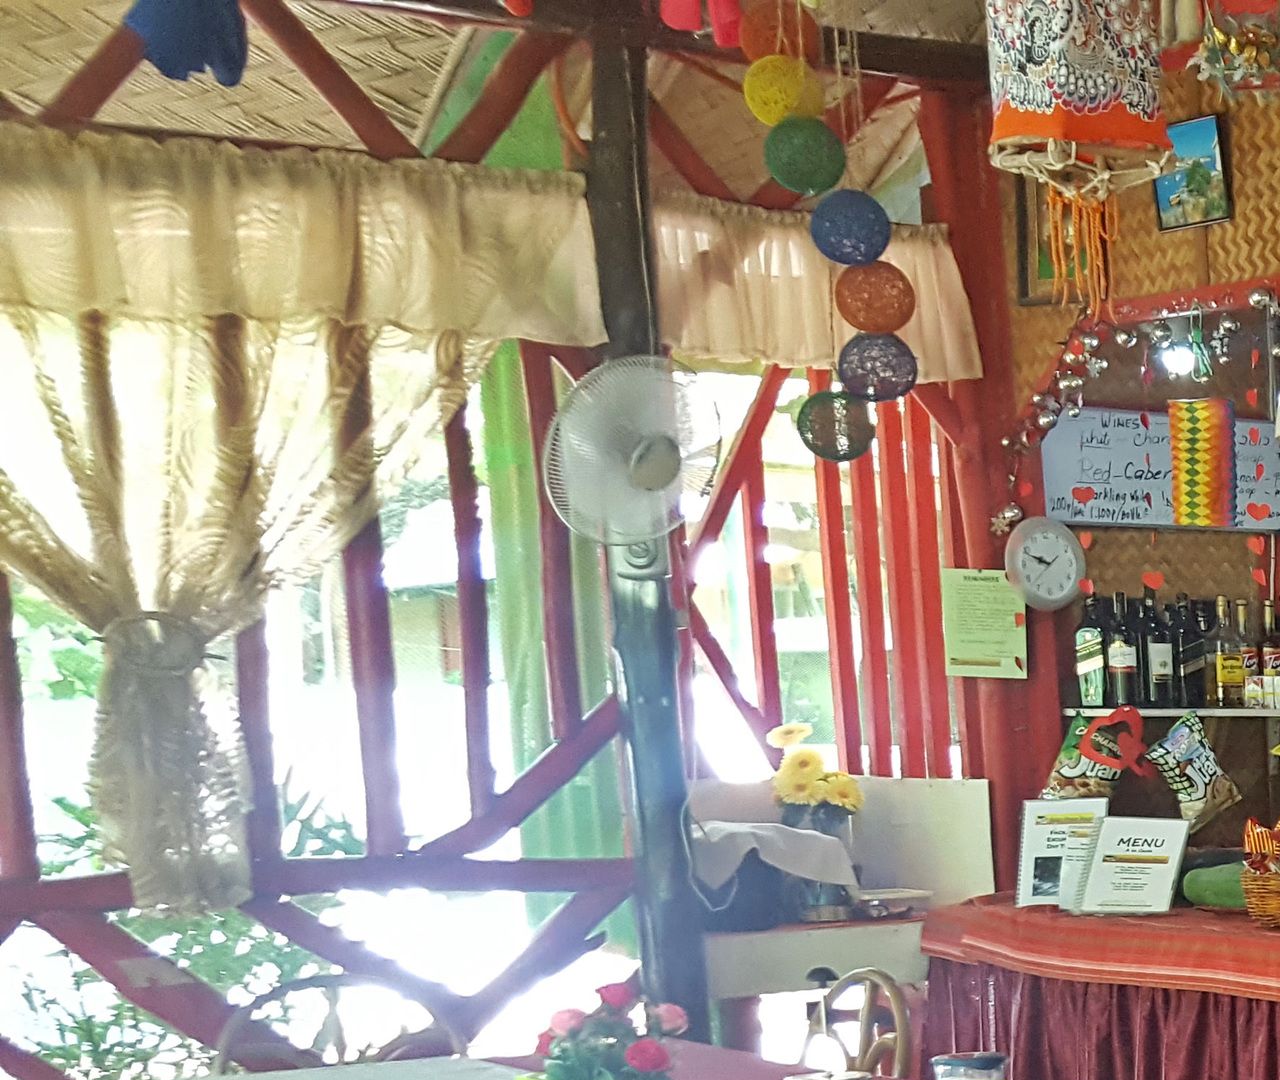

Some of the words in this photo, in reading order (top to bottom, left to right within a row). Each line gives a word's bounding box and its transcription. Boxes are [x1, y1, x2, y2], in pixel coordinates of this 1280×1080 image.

[1101, 412, 1140, 430] WINES
[1059, 754, 1122, 780] Juan
[1116, 836, 1165, 848] MENU
